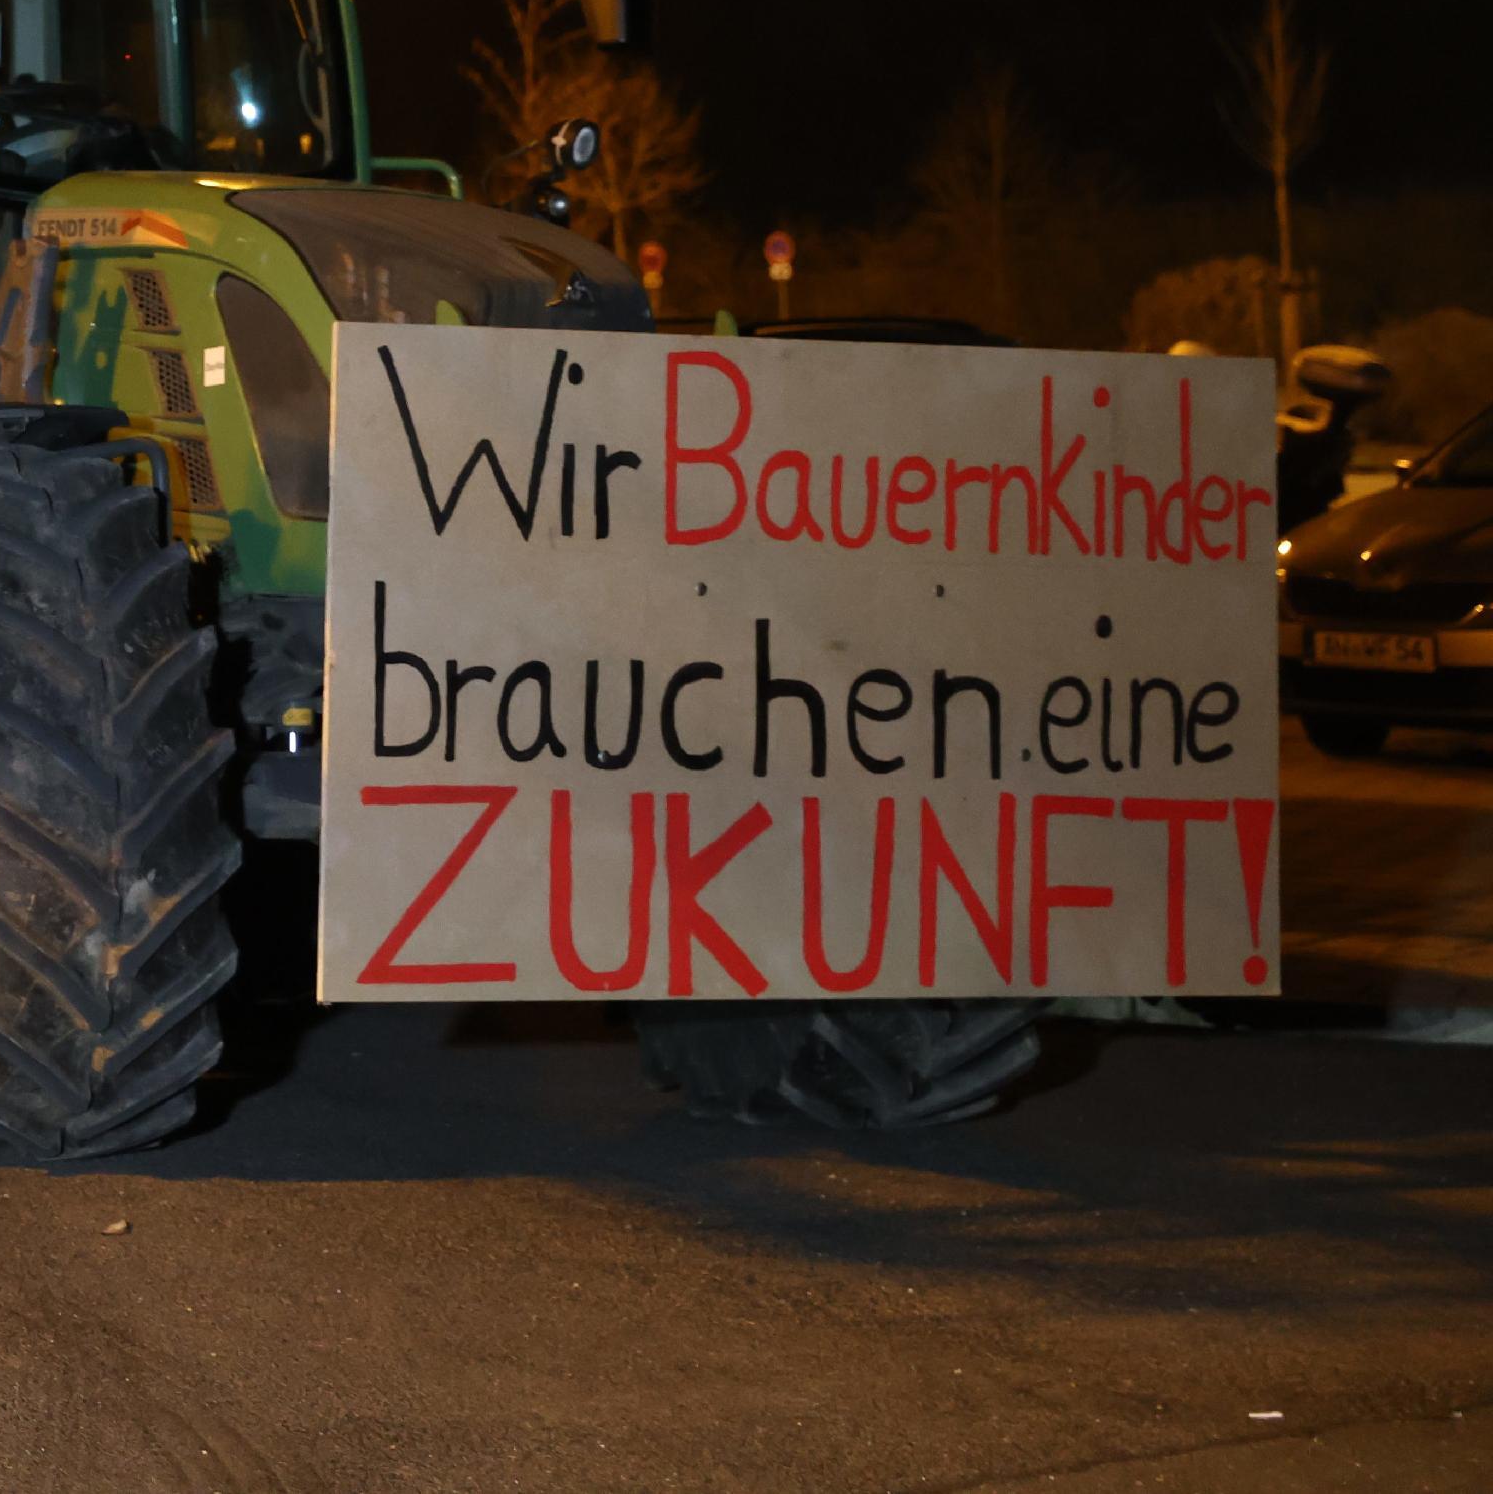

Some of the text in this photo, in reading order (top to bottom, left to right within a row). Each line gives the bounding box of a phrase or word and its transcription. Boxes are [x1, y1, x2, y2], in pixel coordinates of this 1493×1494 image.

[36, 217, 117, 237] FENDT 514
[378, 346, 1273, 565] Wir Bauernkinder
[375, 581, 1240, 779] brauchen eine
[357, 784, 1274, 998] ZUKUNFT!
